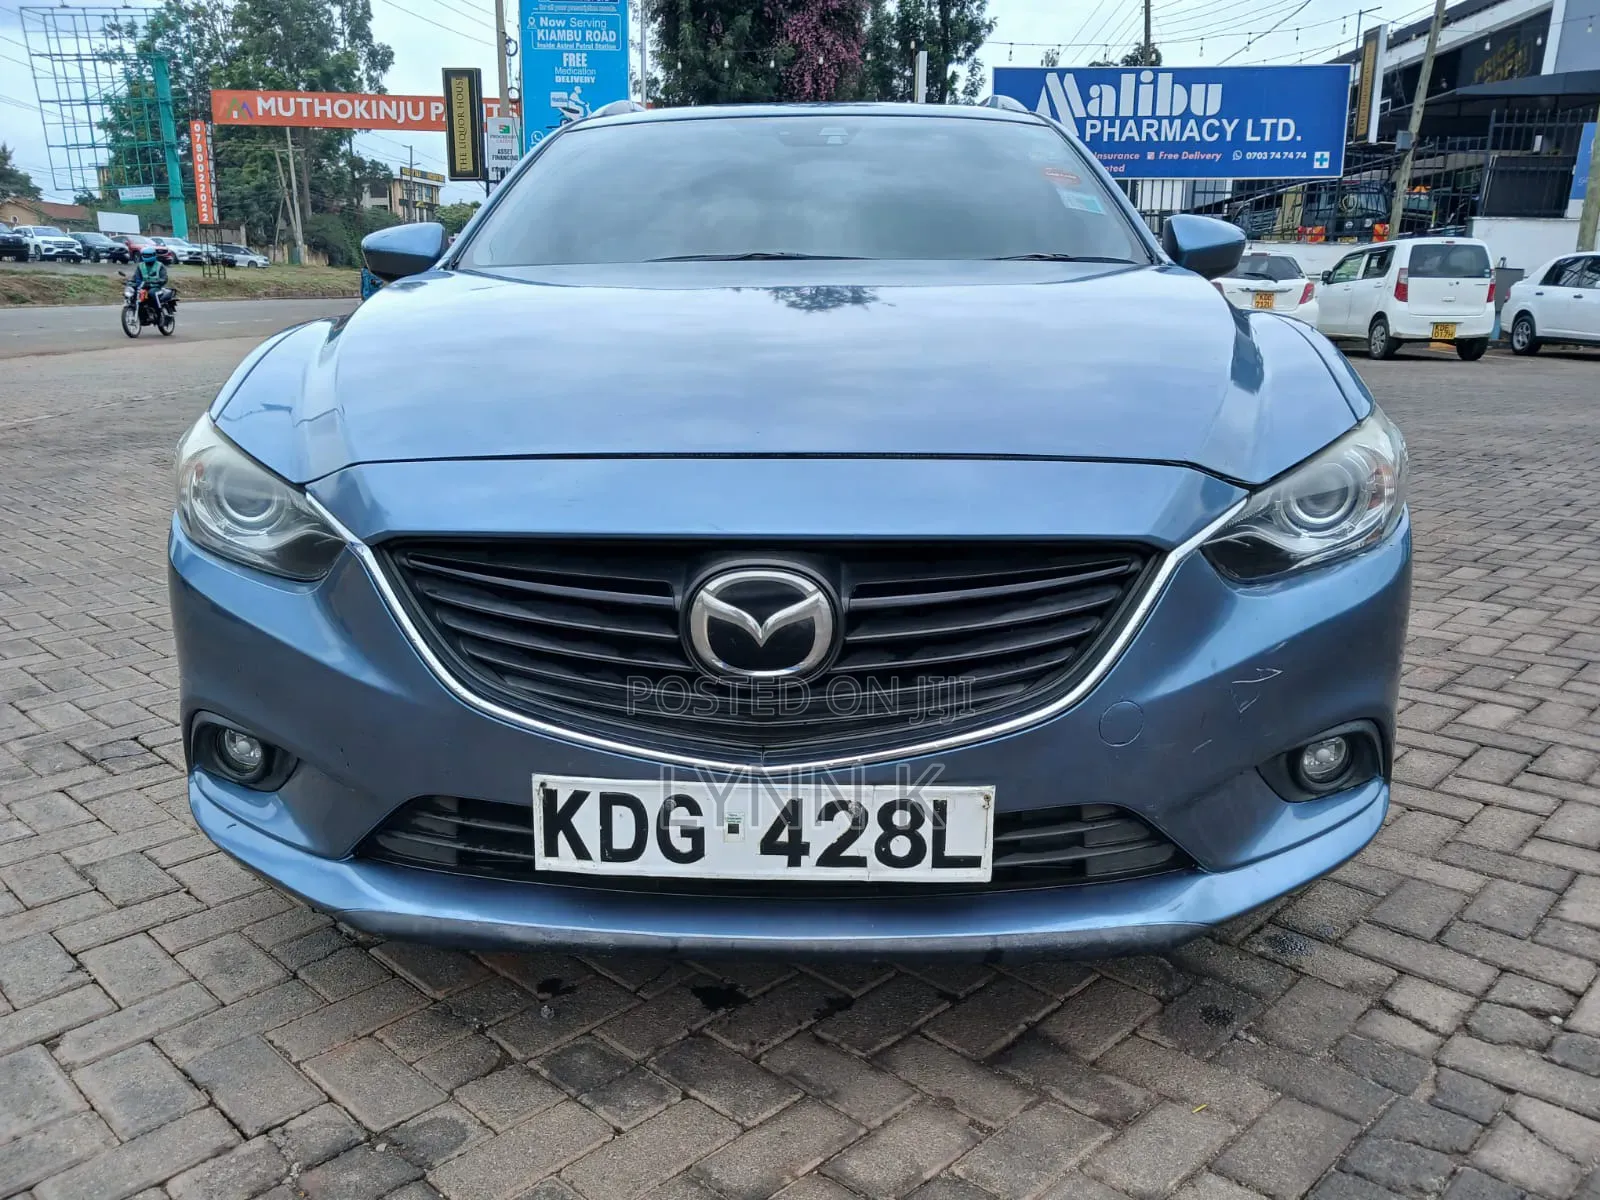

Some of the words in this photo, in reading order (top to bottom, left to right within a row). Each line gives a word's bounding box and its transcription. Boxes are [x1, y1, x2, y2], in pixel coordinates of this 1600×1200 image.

[540, 17, 566, 27] Now
[570, 17, 607, 30] Serving
[537, 29, 582, 41] KIAMBU
[585, 30, 617, 42] ROAD
[562, 52, 588, 67] FREE
[555, 66, 597, 75] Medication
[256, 96, 425, 125] MUTHOKINJU
[1036, 70, 1223, 137] Malibu
[457, 112, 468, 149] LIQUOR
[1085, 118, 1240, 142] PHARMACY
[1245, 118, 1303, 142] LTD.
[1158, 151, 1179, 160] Free
[1181, 151, 1222, 162] Delivery
[1246, 152, 1268, 160] 0703
[1269, 152, 1281, 160] 74
[1282, 152, 1294, 160] 74
[1295, 152, 1307, 160] 74
[543, 788, 706, 864] KDG
[759, 797, 983, 869] 428L
